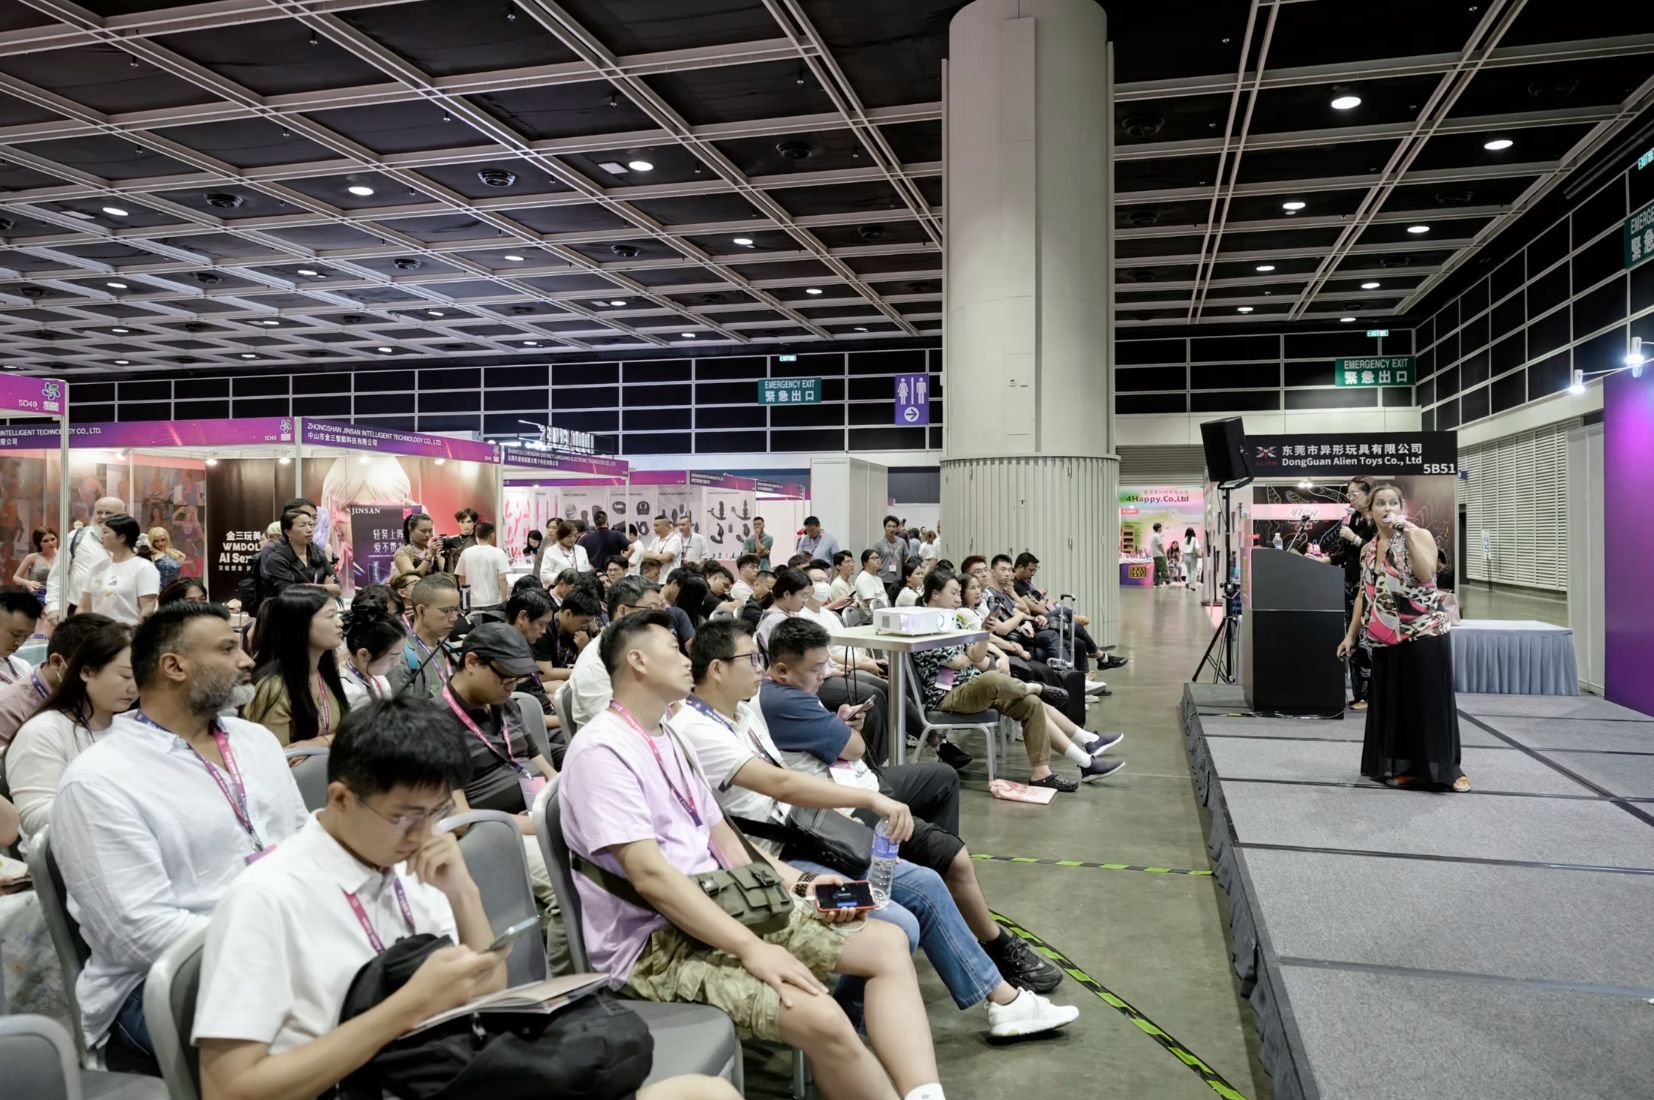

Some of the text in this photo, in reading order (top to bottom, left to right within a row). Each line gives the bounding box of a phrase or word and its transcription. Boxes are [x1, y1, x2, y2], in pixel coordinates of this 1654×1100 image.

[1344, 358, 1408, 370] EMERGENCY EXIT
[1344, 370, 1408, 385] 緊急出口
[764, 379, 815, 389] EMERGENCY EXIT
[765, 390, 814, 402] 緊急出口
[18, 399, 38, 408] 5D49
[307, 422, 342, 433] ZHONGSHAN
[342, 427, 361, 436] JINSAN
[361, 429, 392, 440] INTELLIGENT
[393, 433, 423, 443] TECHNOLOGY
[1282, 443, 1422, 456] 东莞市异形玩具有限公司
[1282, 457, 1331, 468] DongGuan
[1333, 456, 1357, 465] Alien
[1359, 456, 1382, 467] Toys
[1384, 456, 1404, 466] Co.,
[1405, 455, 1422, 465] Ltd
[1423, 463, 1456, 474] 5B51
[351, 507, 381, 515] JINSAN
[222, 542, 263, 551] WMDOL
[219, 552, 231, 563] AI
